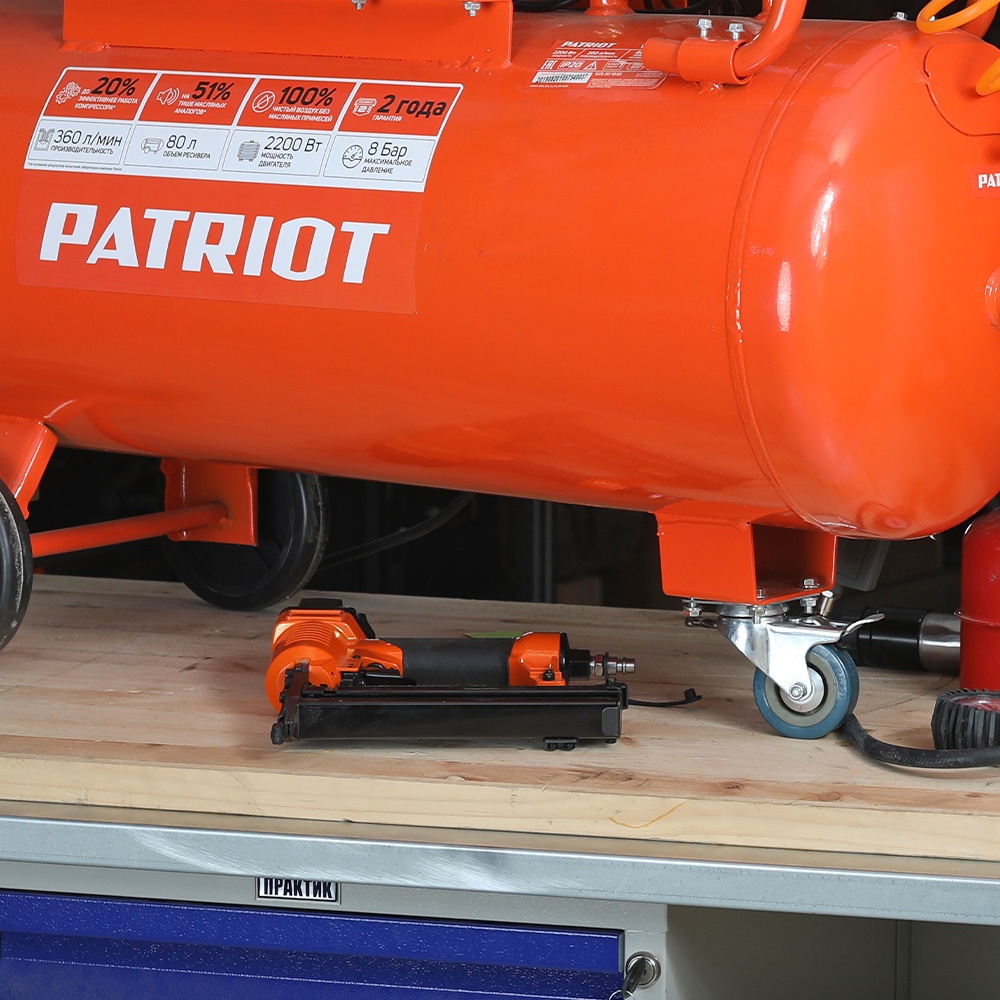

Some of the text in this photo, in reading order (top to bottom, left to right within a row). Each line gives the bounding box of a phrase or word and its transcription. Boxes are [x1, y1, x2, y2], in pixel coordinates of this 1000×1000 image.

[91, 77, 139, 96] 20%
[192, 81, 234, 100] 51%
[279, 86, 337, 106] 100%
[377, 94, 447, 118] 2 года
[54, 129, 122, 146] 360 л/мин
[166, 134, 197, 150] 80 л
[264, 136, 323, 152] 2200 Вт
[50, 145, 113, 155] ПРОИЗВОДИТЕЛЬНОСТЬ
[368, 142, 408, 160] 8 Бар
[364, 158, 413, 166] МАКСИМАЛЬНОЕ
[39, 202, 391, 284] PATRIOT
[264, 878, 332, 898] ПРАКТИК
